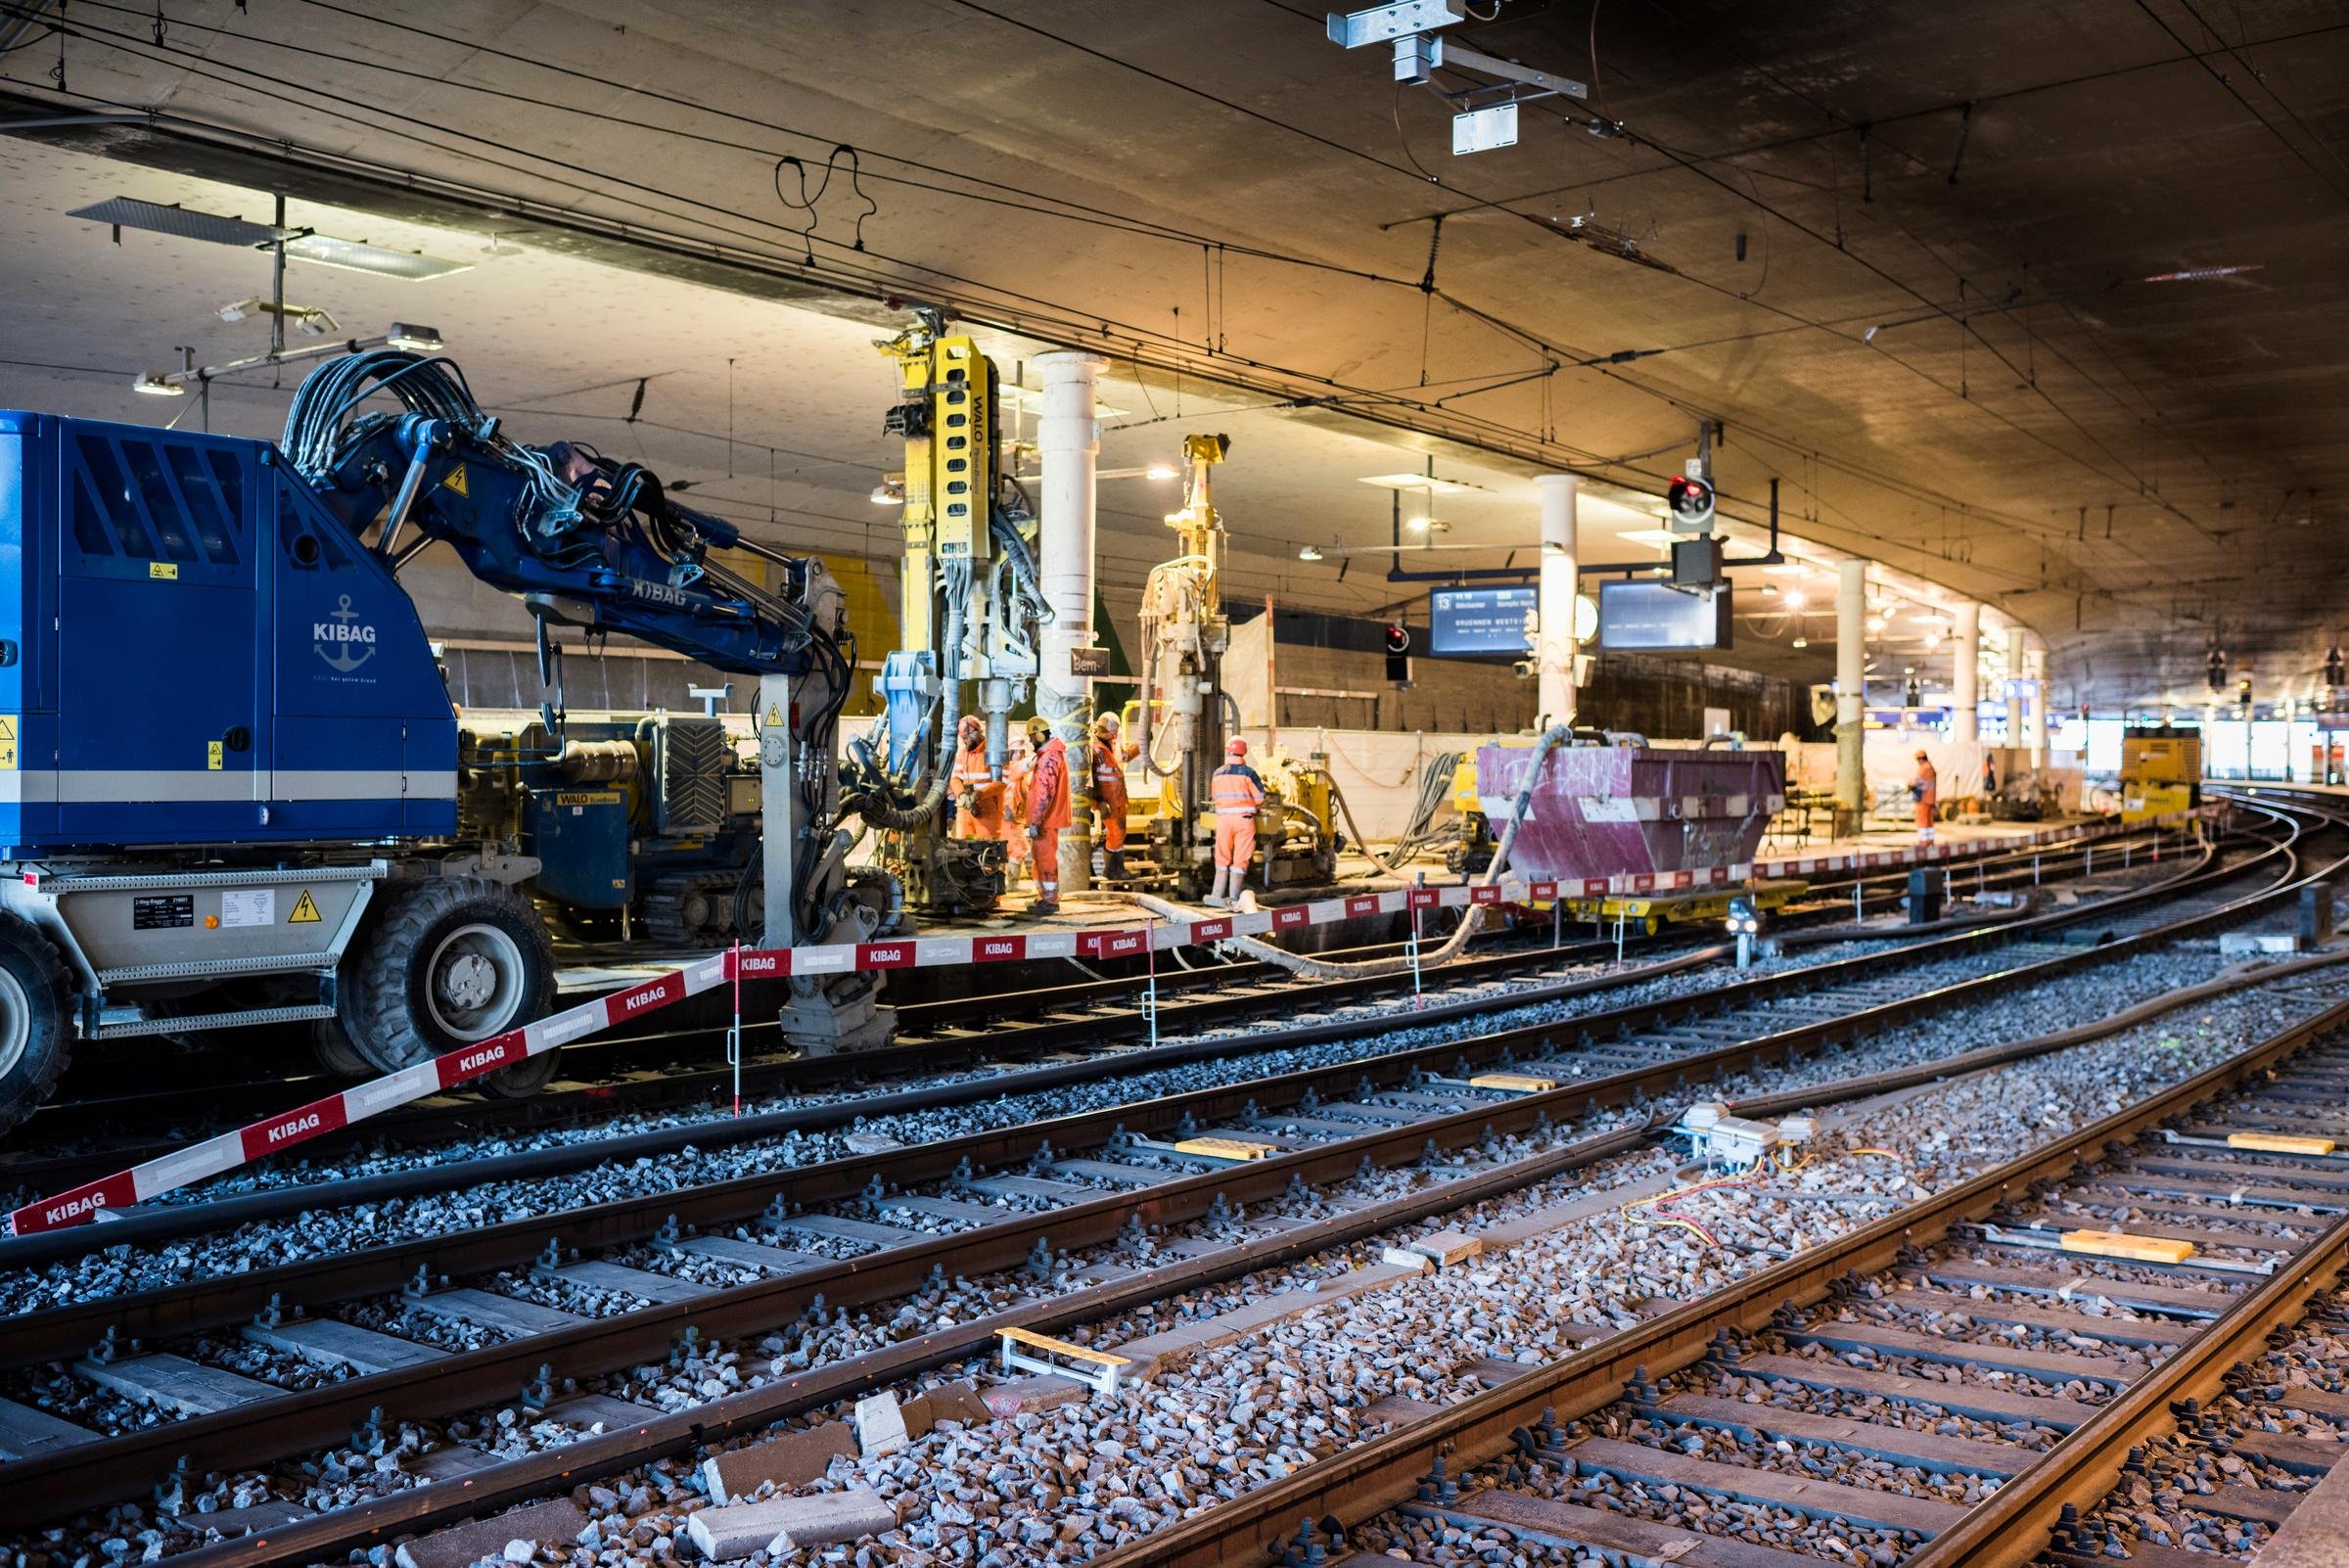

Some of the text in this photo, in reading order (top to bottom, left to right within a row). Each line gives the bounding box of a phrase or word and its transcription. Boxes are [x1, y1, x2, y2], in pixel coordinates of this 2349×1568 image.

[973, 395, 983, 442] WALO
[631, 579, 687, 606] KIBAG
[1438, 598, 1450, 610] 13
[313, 623, 376, 643] KIBAG
[1073, 655, 1096, 672] Bern
[561, 794, 588, 805] WALO
[1354, 900, 1371, 911] KIBAG
[1280, 911, 1302, 923] KIBAG
[1201, 924, 1222, 936] KIBAG
[985, 943, 1013, 955] KIBAG
[1112, 937, 1137, 950] KIBAG
[869, 949, 901, 962] KIBAG
[741, 956, 776, 971] KIBAG
[625, 986, 666, 1010] KIBAG
[459, 1045, 505, 1072] KIBAG
[267, 1113, 320, 1143] KIBAG
[46, 1191, 106, 1224] KIBAG
